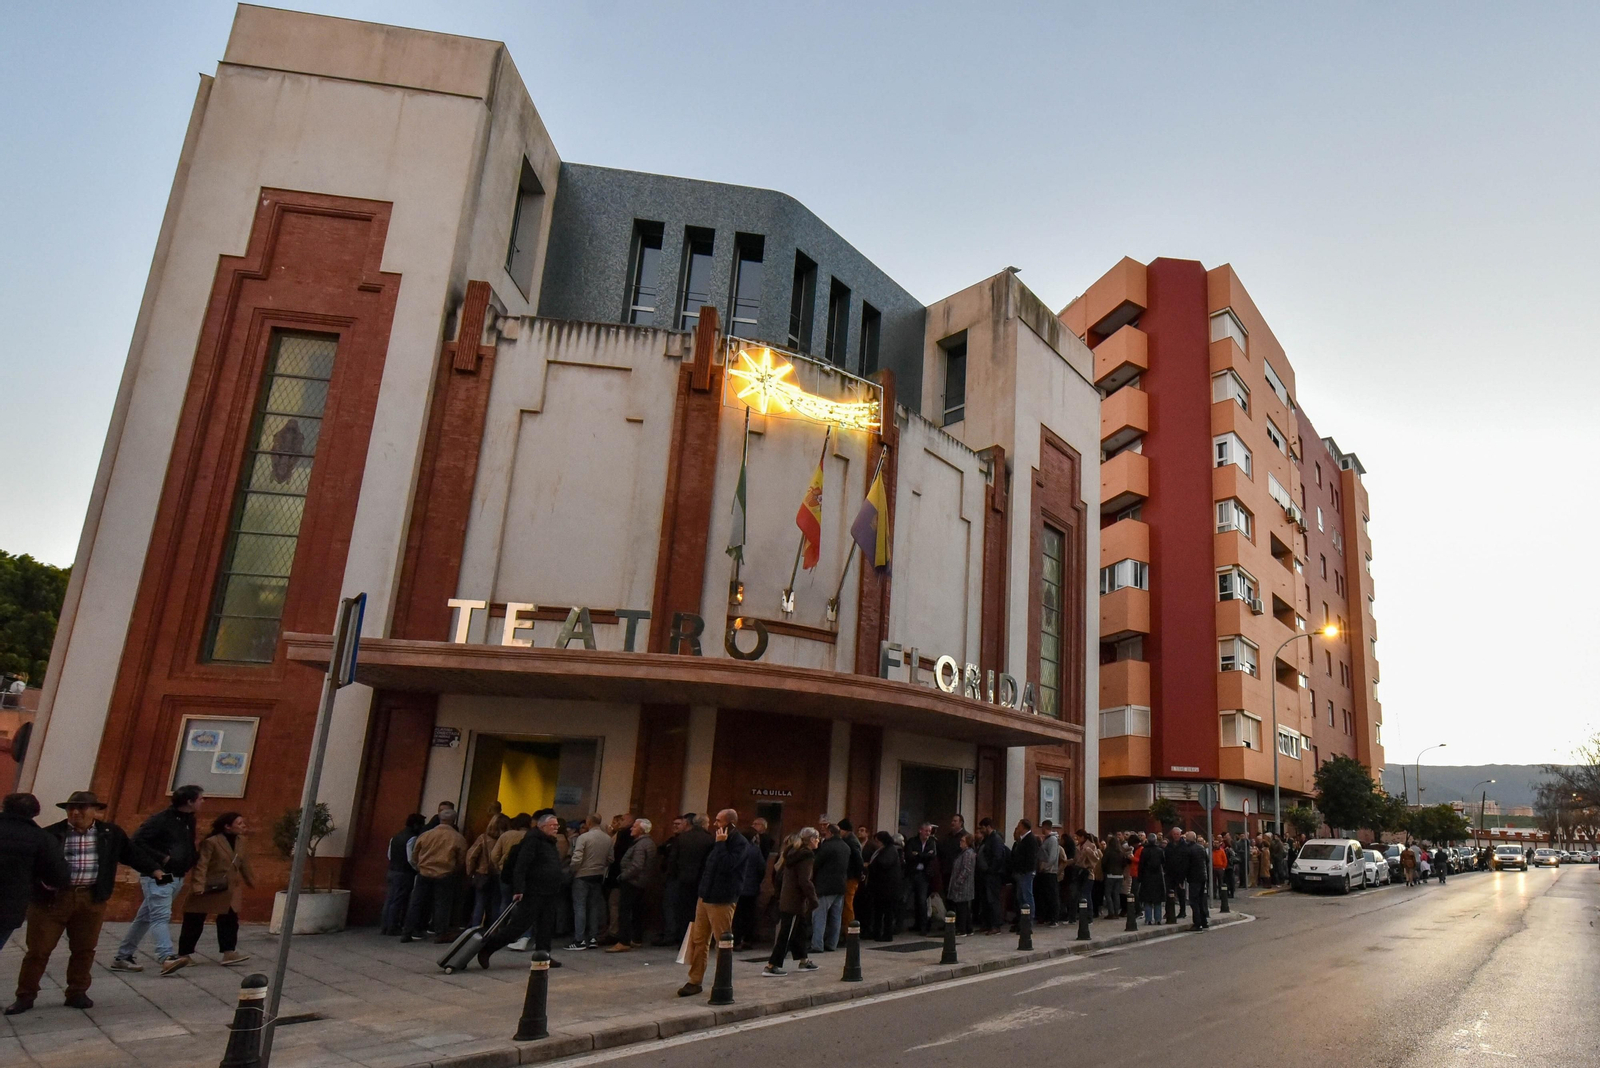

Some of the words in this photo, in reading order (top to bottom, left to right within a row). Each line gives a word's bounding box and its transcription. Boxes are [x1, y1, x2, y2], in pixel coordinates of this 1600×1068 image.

[448, 598, 769, 661] TEATRO
[879, 640, 1038, 715] FLORIDA
[751, 789, 792, 797] TAQUILLA
